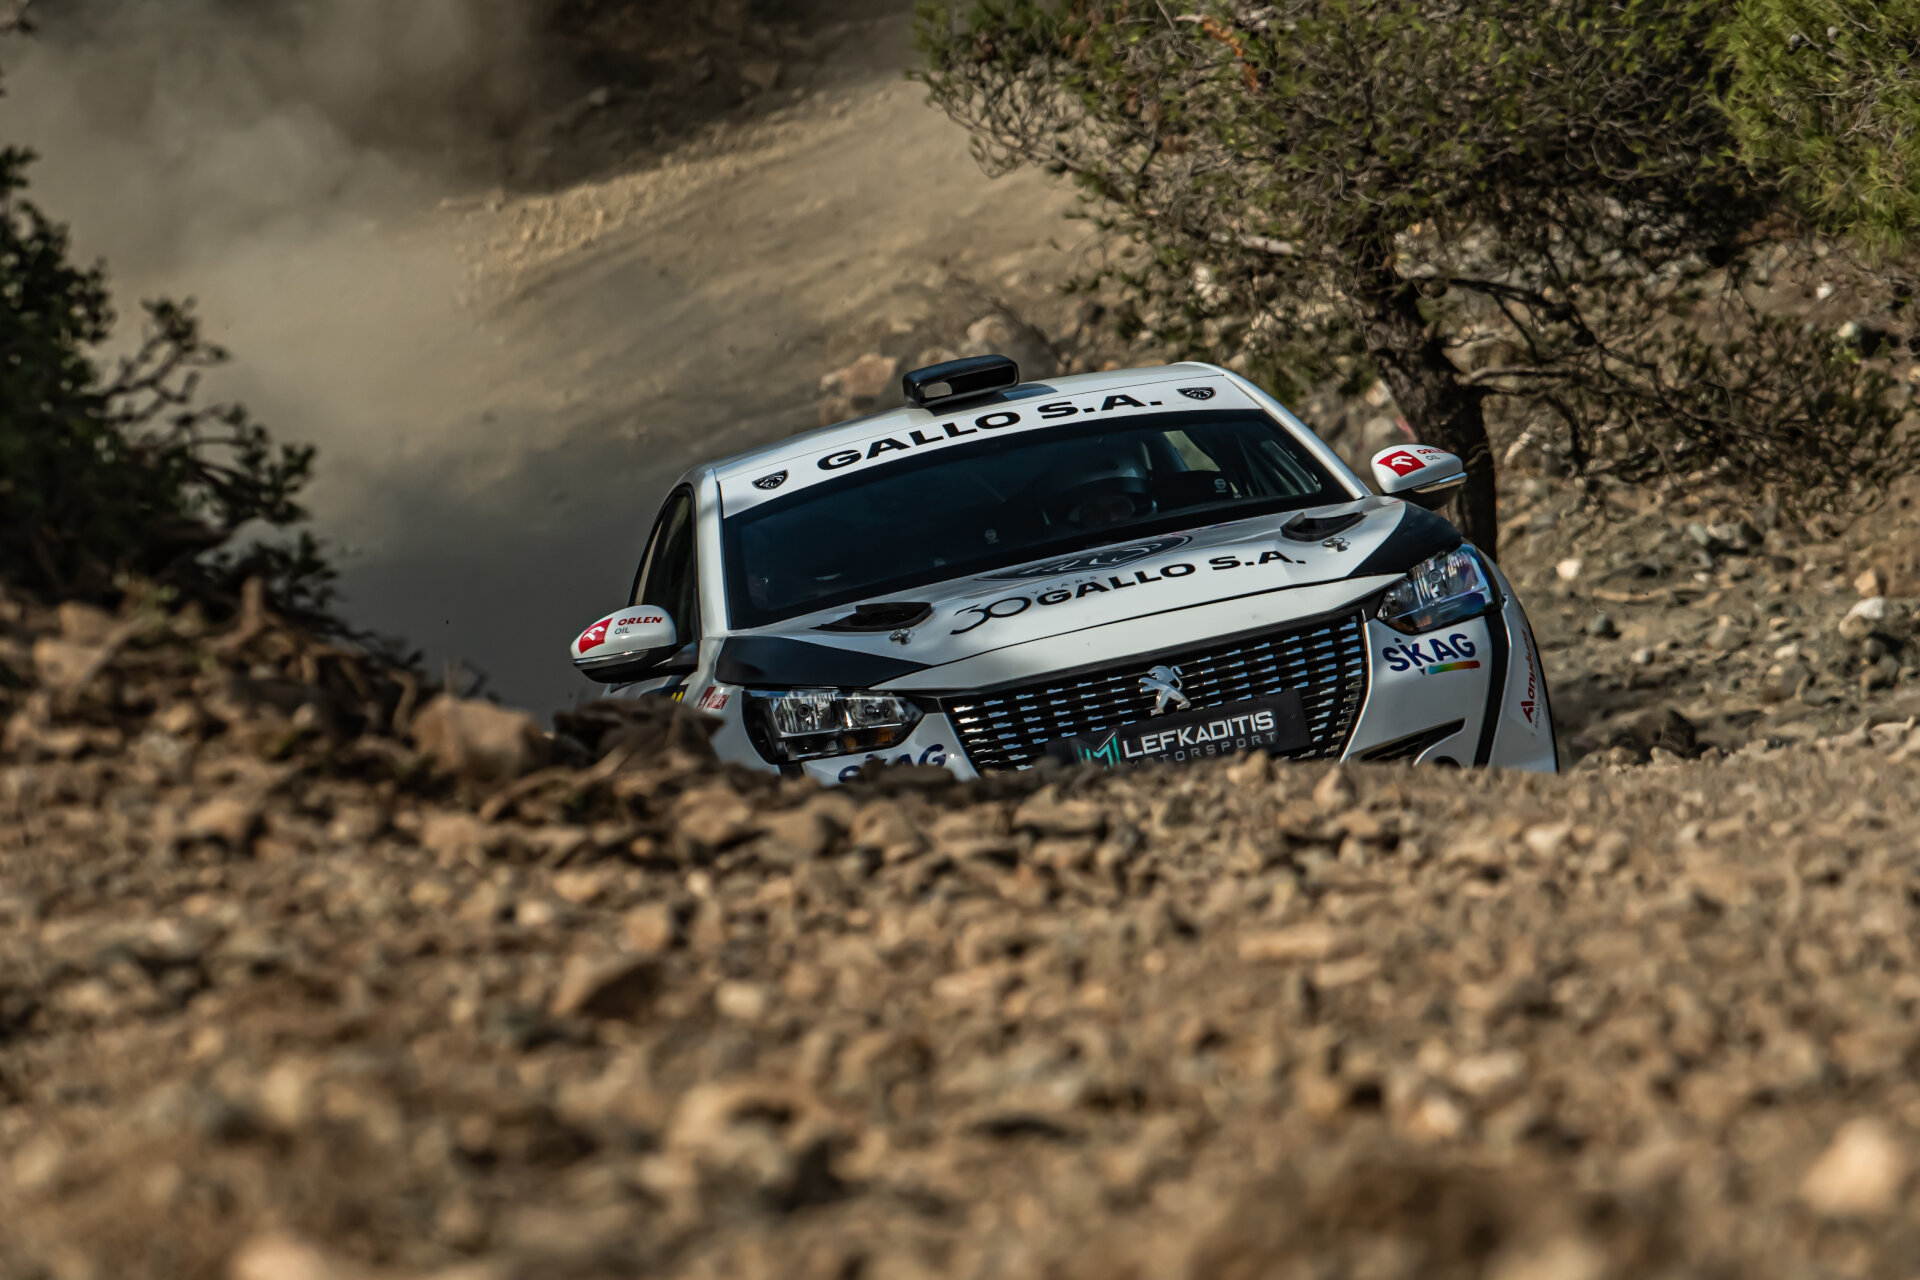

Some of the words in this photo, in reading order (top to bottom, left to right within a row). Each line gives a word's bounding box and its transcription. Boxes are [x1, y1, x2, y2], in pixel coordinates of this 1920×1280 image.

[817, 411, 1021, 471] GALLO
[1037, 394, 1163, 419] S.A.
[950, 597, 1032, 635] 30
[1036, 563, 1196, 606] GALLO
[1208, 550, 1306, 571] S.A.
[614, 627, 630, 635] OIL
[617, 616, 663, 626] ORLEN
[1382, 633, 1476, 672] SKAG
[1122, 710, 1275, 759] LEFKADITIS
